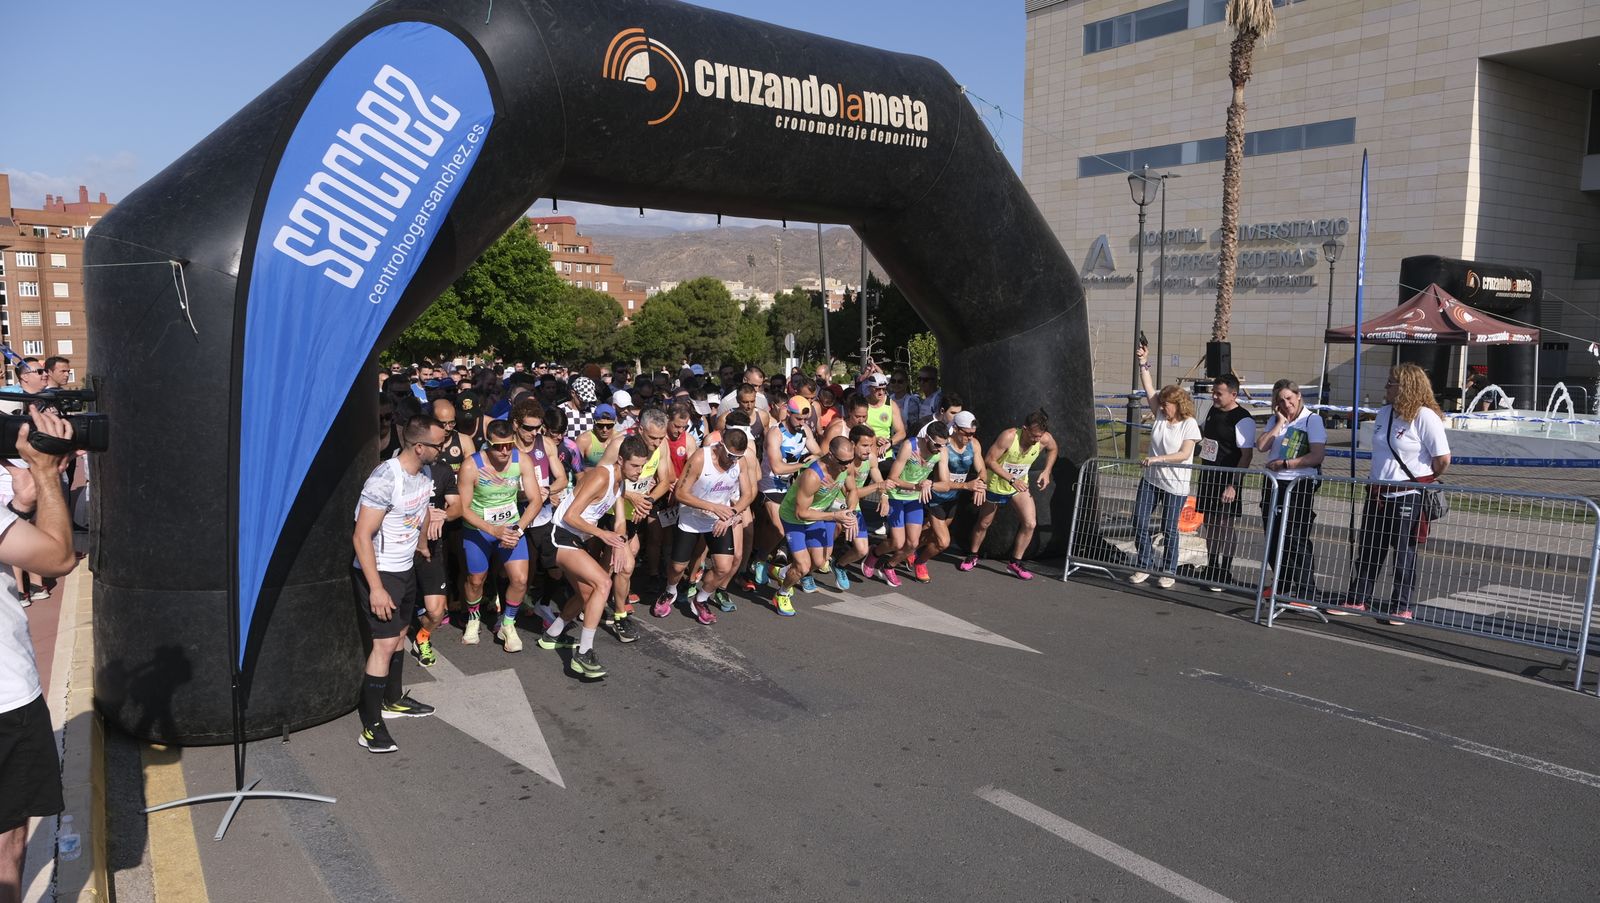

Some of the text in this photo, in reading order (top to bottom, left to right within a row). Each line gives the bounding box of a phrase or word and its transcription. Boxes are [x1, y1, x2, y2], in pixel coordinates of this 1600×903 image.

[694, 58, 929, 132] cruzandolameta
[775, 114, 928, 149] cronometraje deportivo
[368, 123, 485, 305] centrohogarsanchez.es
[1218, 217, 1349, 241] IVERSITARIO
[1162, 247, 1318, 272] TORRERDENAS
[1153, 277, 1198, 289] HSPITAL
[632, 480, 648, 490] 109
[491, 510, 512, 521] 159
